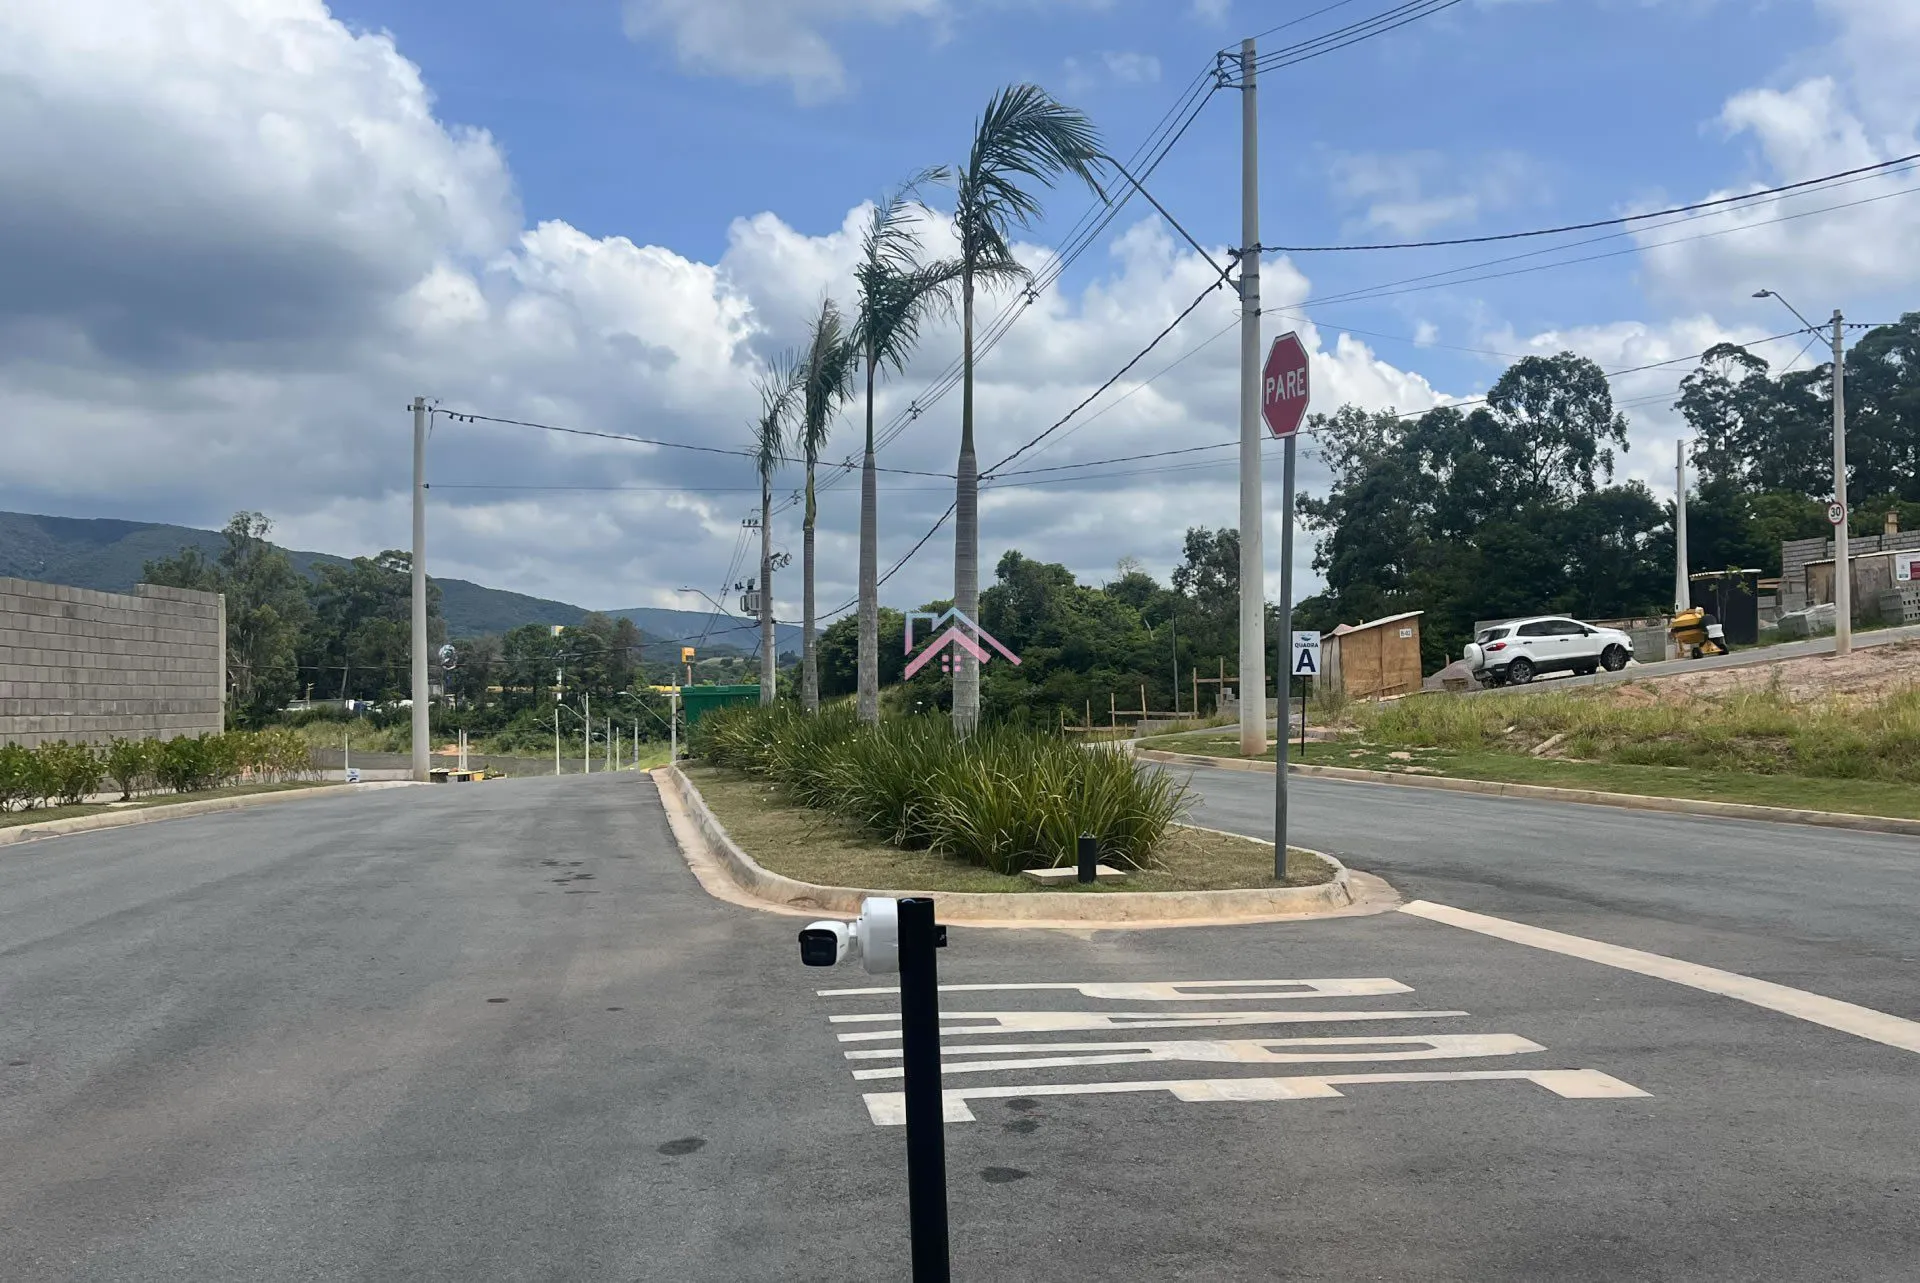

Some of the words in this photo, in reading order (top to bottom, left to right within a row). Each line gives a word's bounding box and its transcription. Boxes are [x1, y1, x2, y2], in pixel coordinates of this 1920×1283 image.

[1266, 368, 1305, 404] PARE
[1830, 506, 1841, 517] 30
[1296, 649, 1316, 672] A
